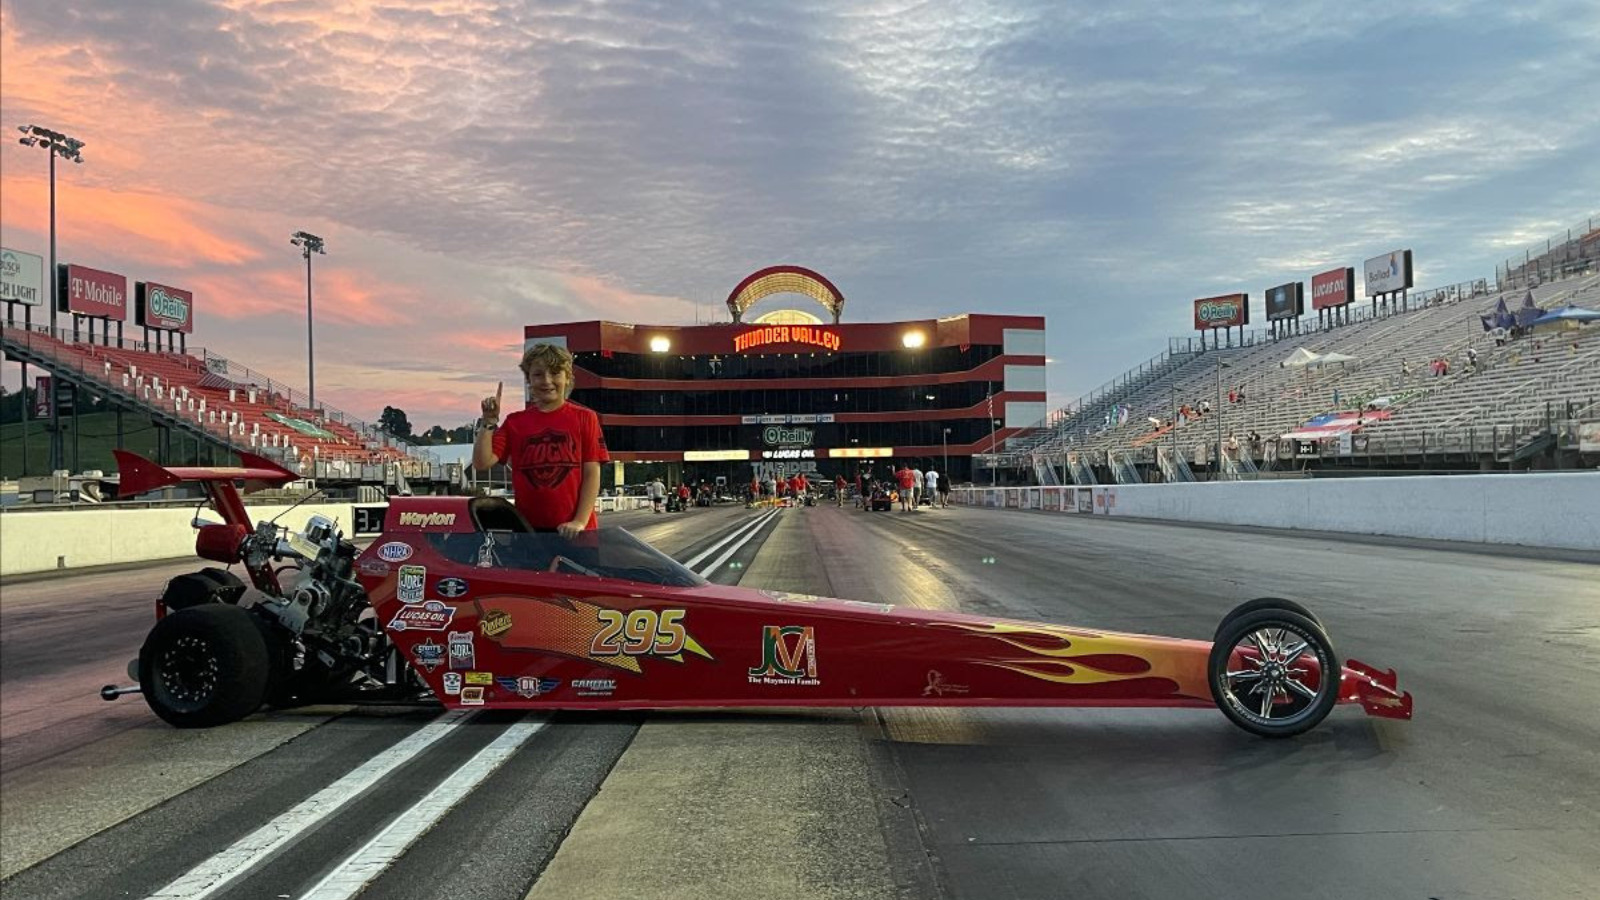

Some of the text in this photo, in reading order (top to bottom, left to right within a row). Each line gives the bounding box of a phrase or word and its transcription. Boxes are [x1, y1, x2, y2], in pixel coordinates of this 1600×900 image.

[12, 283, 36, 302] LIGHT
[85, 280, 121, 307] Mobile
[1314, 279, 1345, 298] LUCAS OIL
[151, 289, 188, 324] O'Reilly
[734, 326, 839, 353] THUNDER VALLEY
[764, 427, 812, 445] O'Reilly
[773, 450, 800, 459] LUCAS
[801, 450, 815, 458] OIL
[383, 547, 408, 559] NHRA
[400, 611, 445, 621] LUCAS OIL
[590, 609, 686, 654] 295
